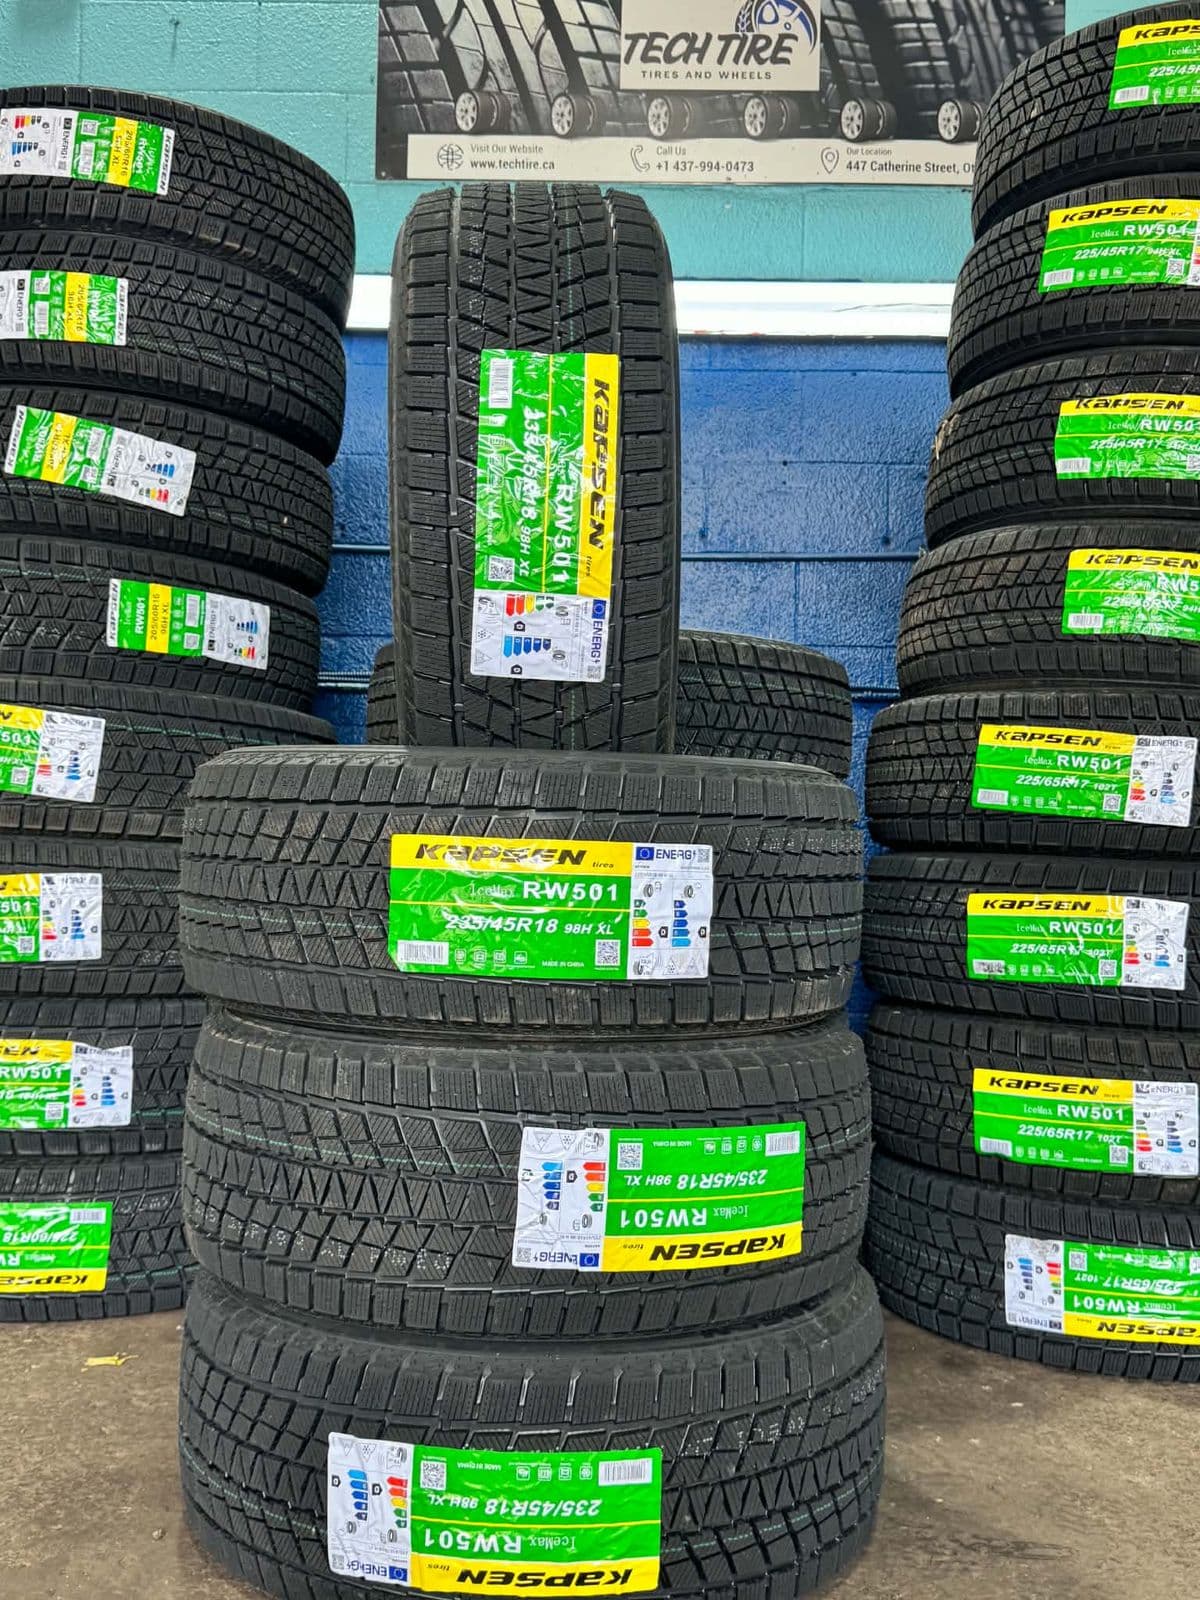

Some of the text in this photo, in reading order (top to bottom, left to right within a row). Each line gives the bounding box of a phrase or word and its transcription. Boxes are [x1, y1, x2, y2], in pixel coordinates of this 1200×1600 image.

[623, 32, 799, 66] TECH TIRE
[641, 70, 772, 80] TIRES AND WHEELS
[470, 143, 544, 155] Visit Our Website
[656, 145, 687, 156] Call Us
[846, 147, 892, 157] Our Location
[470, 158, 555, 171] www.techtire.ca
[656, 160, 754, 173] +1 437-994-0473
[846, 160, 867, 172] 447
[870, 160, 922, 173] Catherine
[925, 161, 960, 175] Street,
[1073, 245, 1145, 260] 225/45R17
[519, 525, 531, 554] 98H
[552, 484, 574, 584] RW501
[518, 557, 530, 577] XL
[1057, 755, 1121, 770] RW501
[1016, 774, 1089, 788] 225/65R17
[592, 860, 615, 869] tires
[523, 880, 619, 902] RW501
[445, 914, 615, 935] 235/45R18 98H XL
[1049, 921, 1115, 935] RW501
[1057, 1104, 1124, 1121] RW501
[1017, 1123, 1094, 1140] 225/65R17
[623, 1168, 768, 1190] 235/45R18 98H XL
[620, 1205, 749, 1228] IceMax RW501
[427, 1493, 602, 1516] 235/45R18 98H XL
[424, 1527, 577, 1554] IceMax RW501
[427, 1563, 450, 1571] tires
